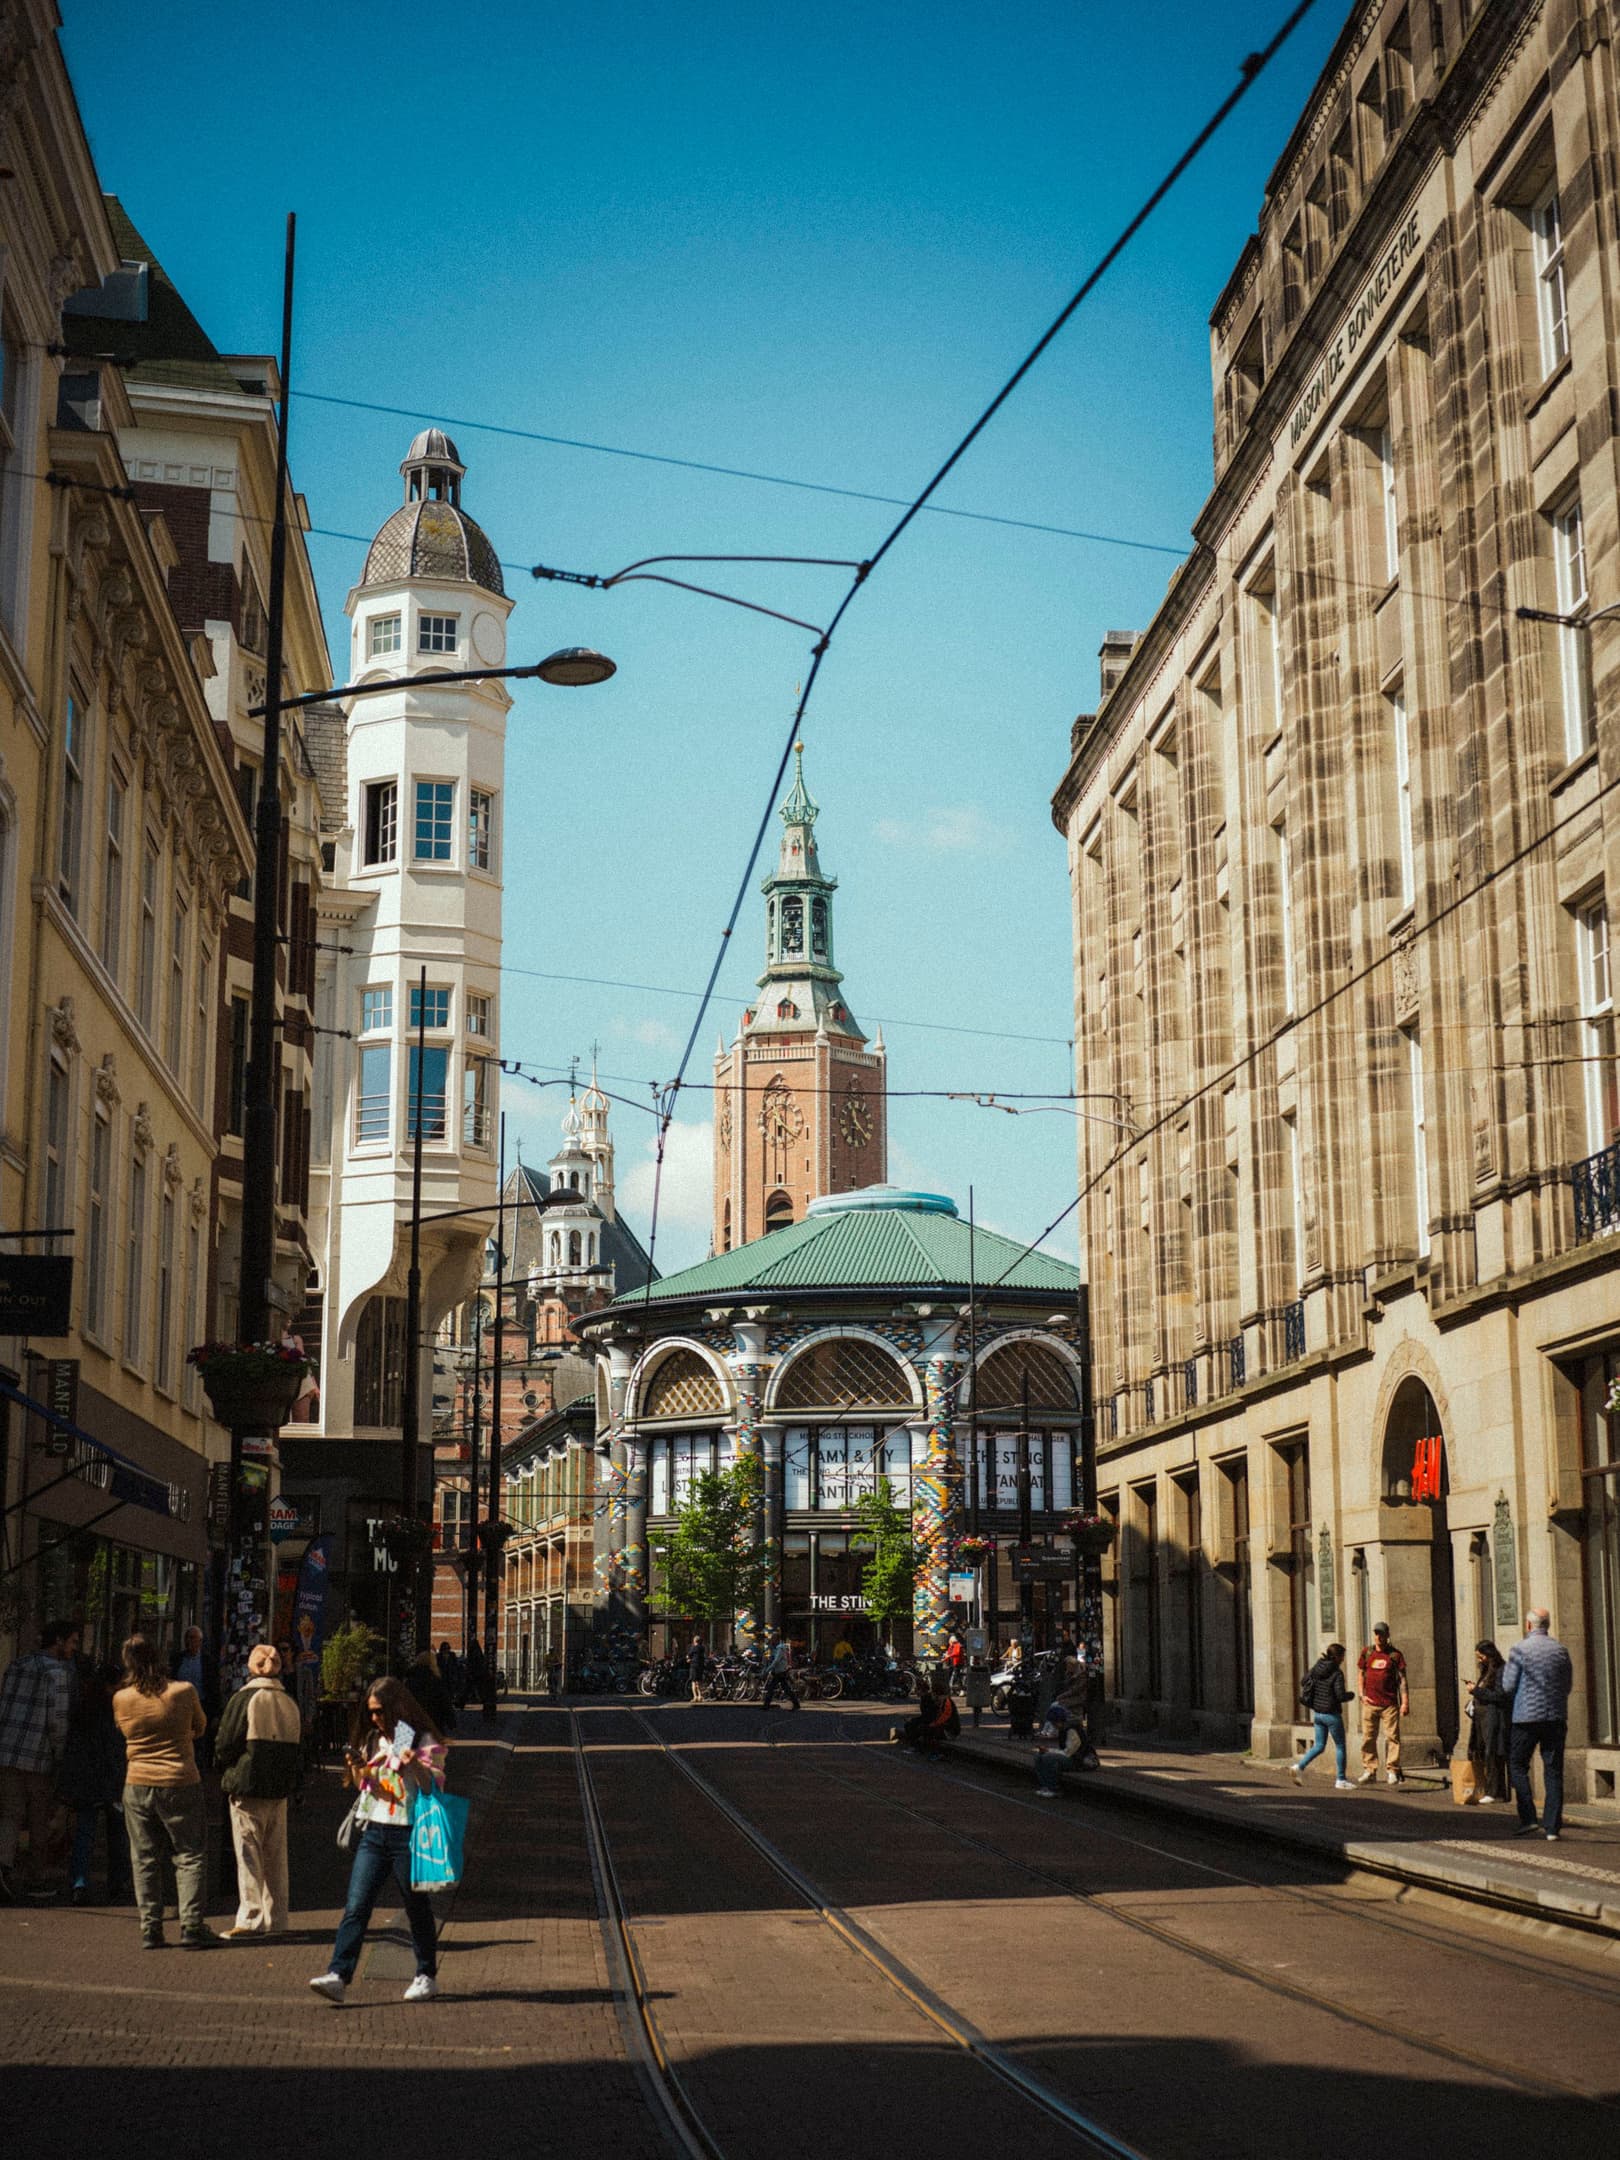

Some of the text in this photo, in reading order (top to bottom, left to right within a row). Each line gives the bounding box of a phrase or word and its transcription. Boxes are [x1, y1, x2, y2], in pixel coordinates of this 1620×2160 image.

[1291, 210, 1420, 448] MAISON DE BONNETERIE
[854, 1450, 864, 1462] &
[270, 1510, 296, 1519] RAM
[270, 1522, 297, 1530] DAGE
[810, 1595, 873, 1609] THE STIN
